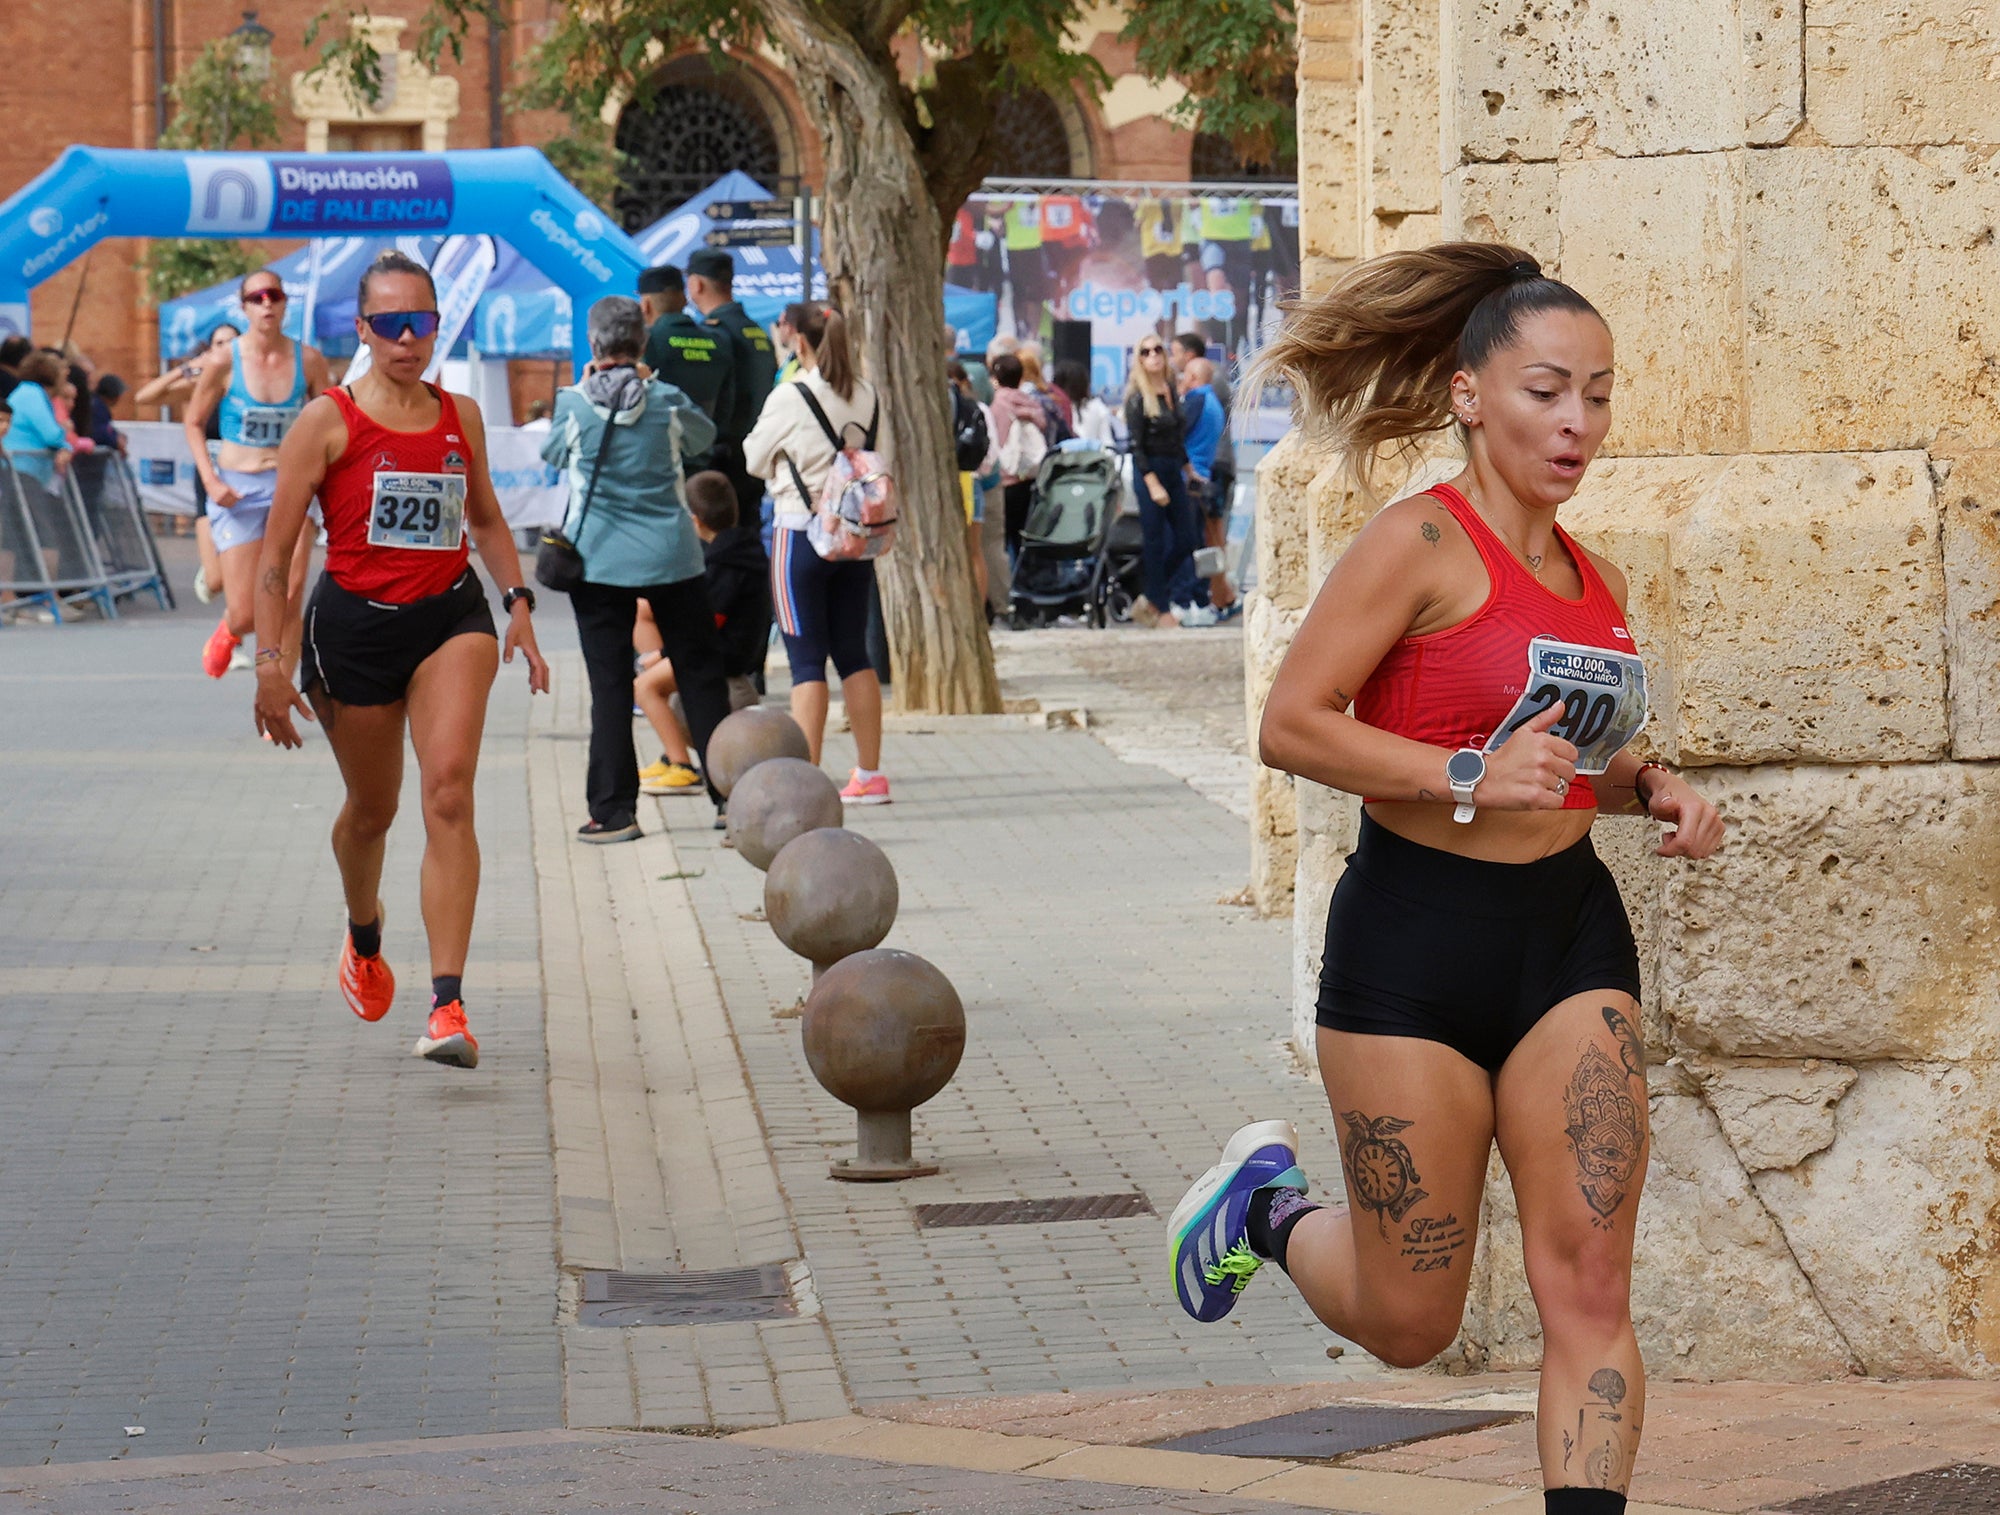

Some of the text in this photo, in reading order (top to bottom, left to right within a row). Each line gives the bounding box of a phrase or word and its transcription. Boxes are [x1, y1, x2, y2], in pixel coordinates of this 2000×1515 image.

[279, 166, 418, 195] Diputación
[281, 198, 448, 222] DE PALENCIA
[22, 211, 108, 278] deportes
[529, 209, 614, 283] deportes
[1069, 281, 1236, 325] deportes
[246, 420, 282, 439] 211
[377, 495, 440, 532] 329
[1547, 664, 1618, 685] MARIANO HARO
[1566, 655, 1605, 673] 10.000
[1508, 683, 1616, 748] 290
